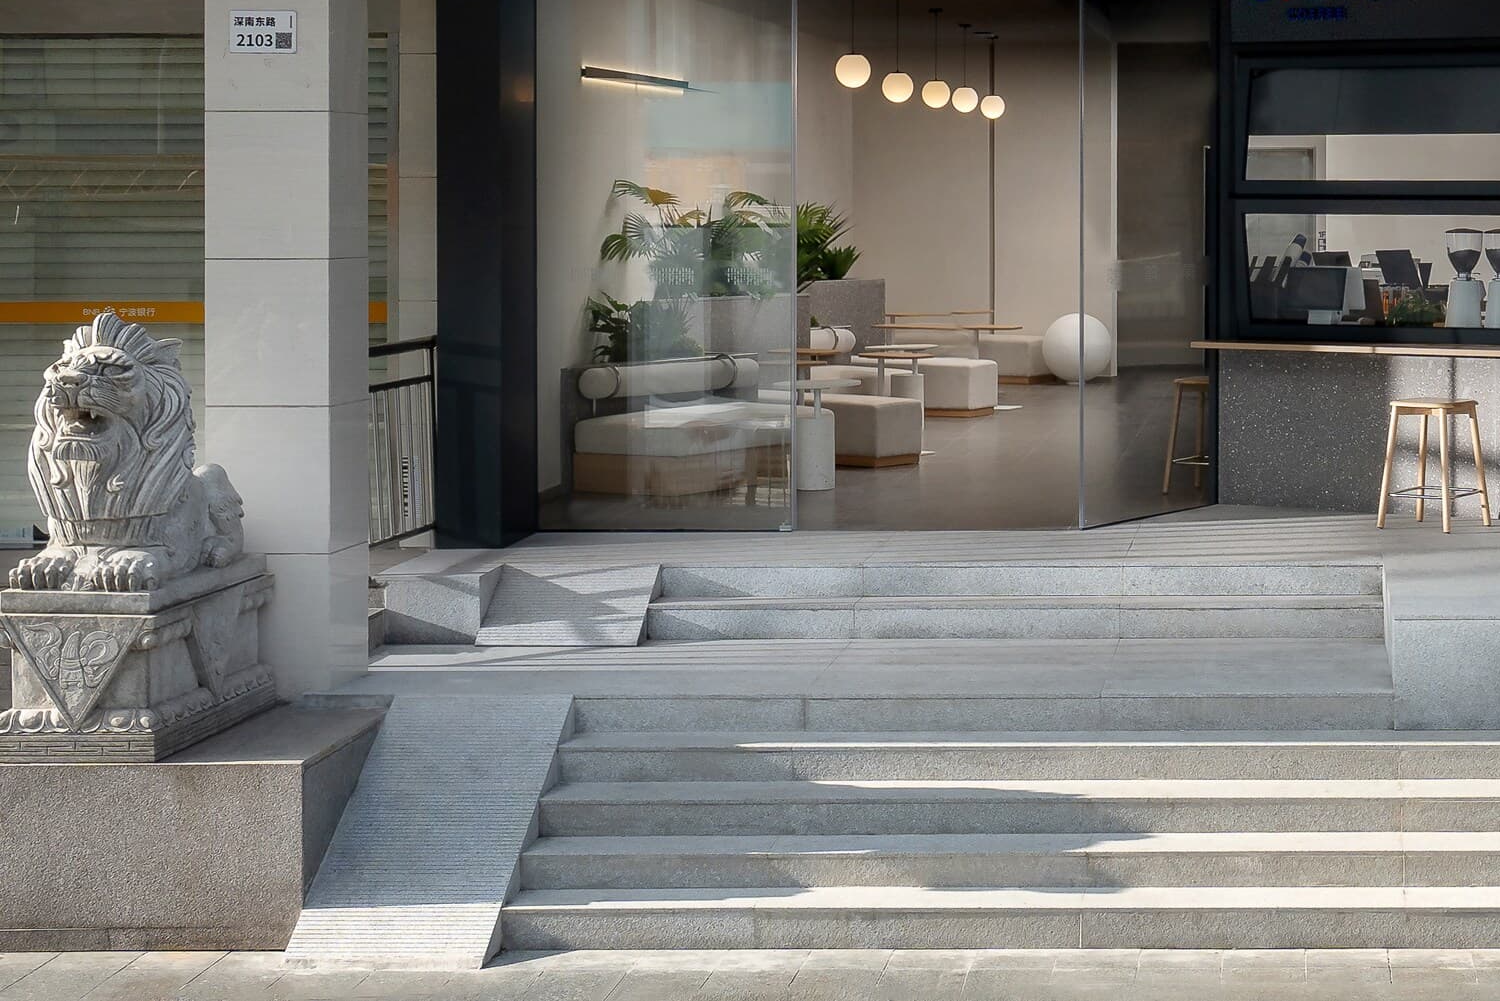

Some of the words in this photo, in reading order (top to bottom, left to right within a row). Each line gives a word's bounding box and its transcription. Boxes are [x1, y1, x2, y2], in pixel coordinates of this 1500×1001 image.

[233, 16, 276, 27] 深南东路
[236, 33, 273, 47] 2103
